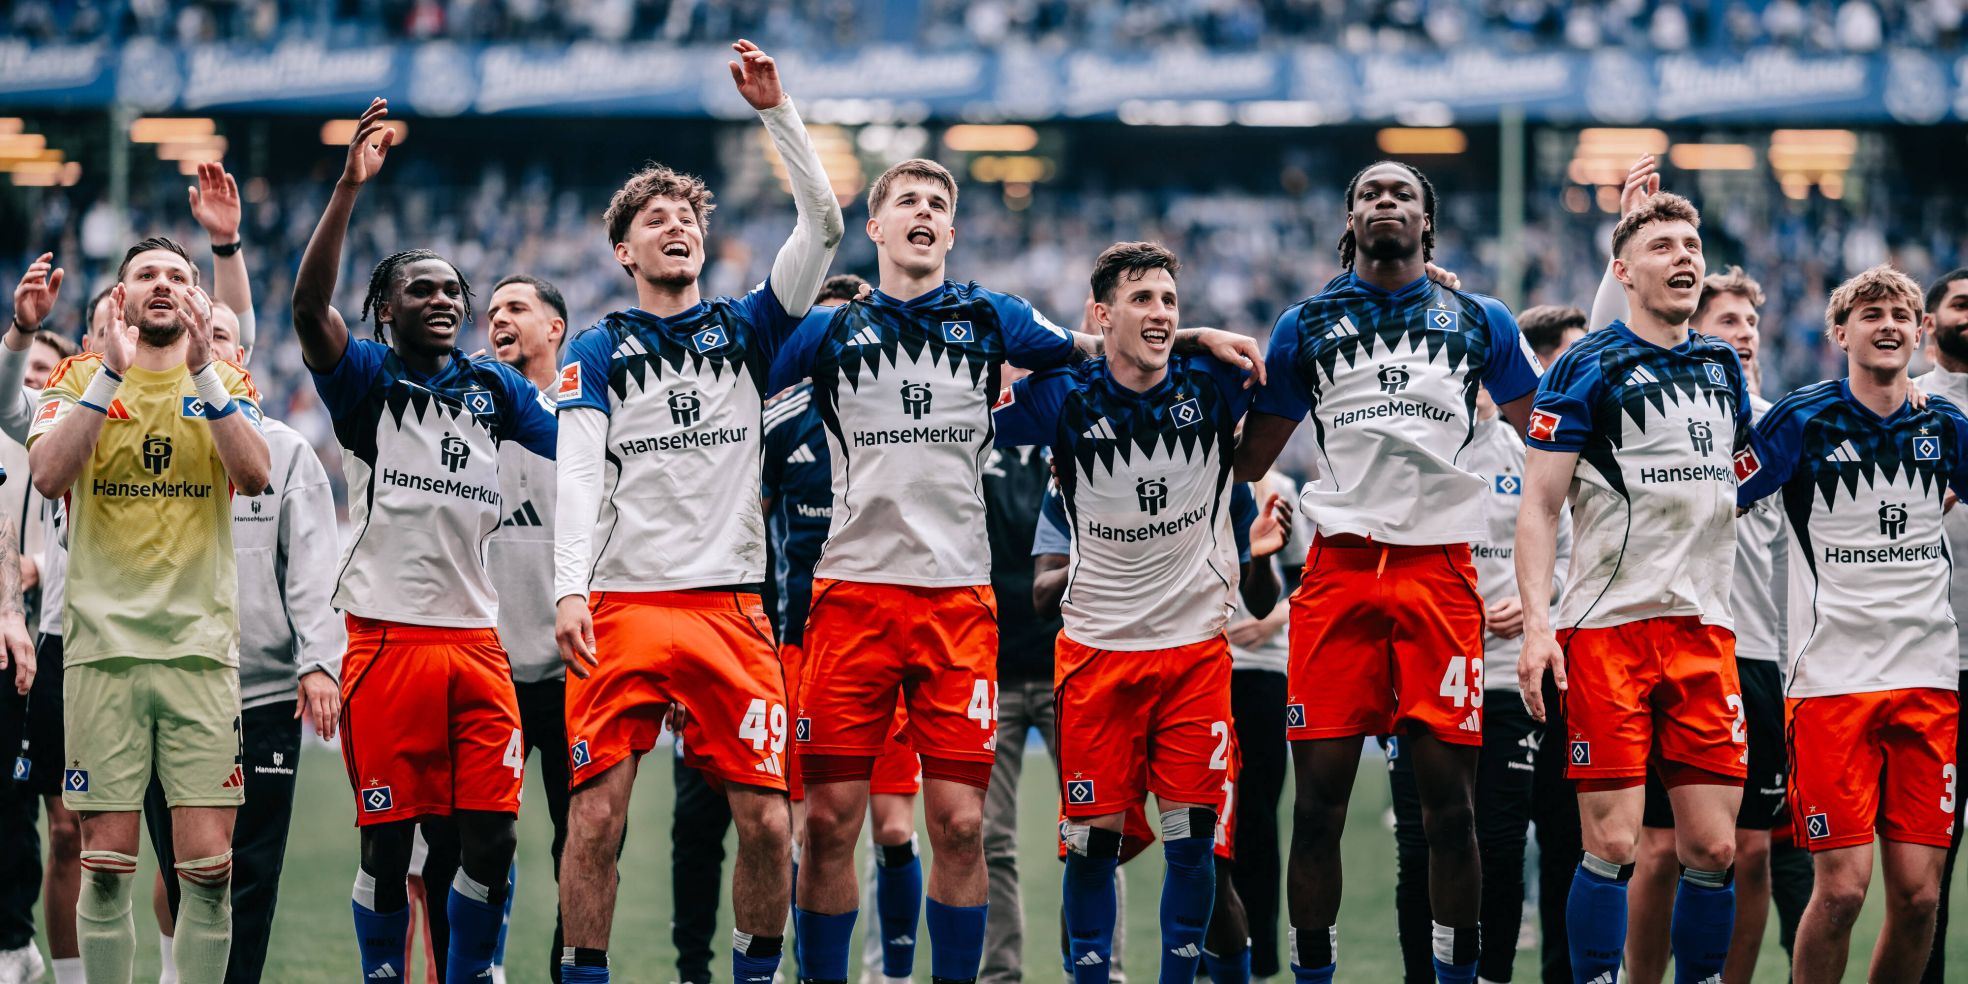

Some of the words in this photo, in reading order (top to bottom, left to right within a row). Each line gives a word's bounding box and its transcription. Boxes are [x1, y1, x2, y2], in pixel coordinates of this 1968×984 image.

[1333, 400, 1456, 430] HanseMerkur
[618, 426, 748, 456] HanseMerkur
[853, 426, 976, 448] HanseMerkur
[92, 478, 212, 498] HanseMerkur
[382, 467, 500, 506] HanseMerkur
[1088, 502, 1208, 543] HanseMerkur
[1824, 544, 1941, 564] HanseMerkur
[1439, 656, 1484, 708] 43
[738, 698, 788, 754] 49
